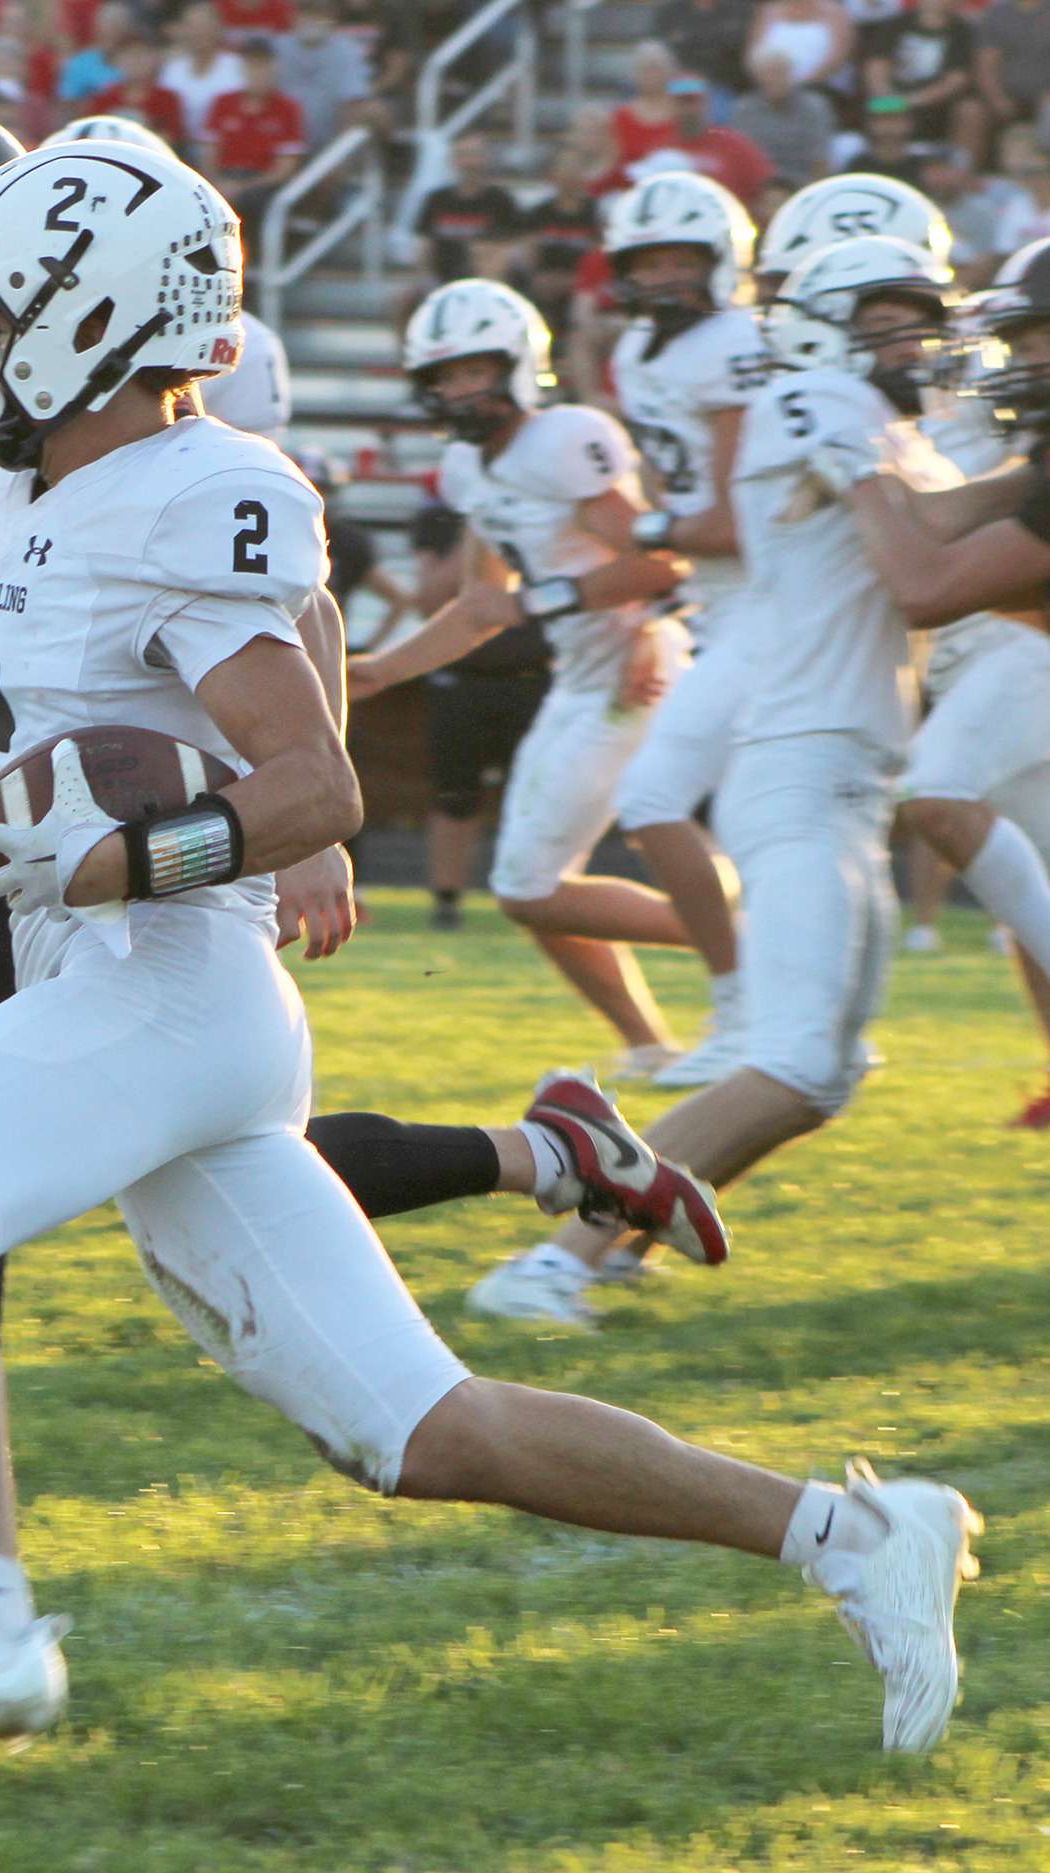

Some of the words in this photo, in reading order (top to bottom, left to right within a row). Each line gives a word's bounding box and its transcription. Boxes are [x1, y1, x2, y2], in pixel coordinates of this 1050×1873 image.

[45, 177, 87, 232] 2
[776, 389, 816, 440] 5
[231, 499, 269, 575] 2
